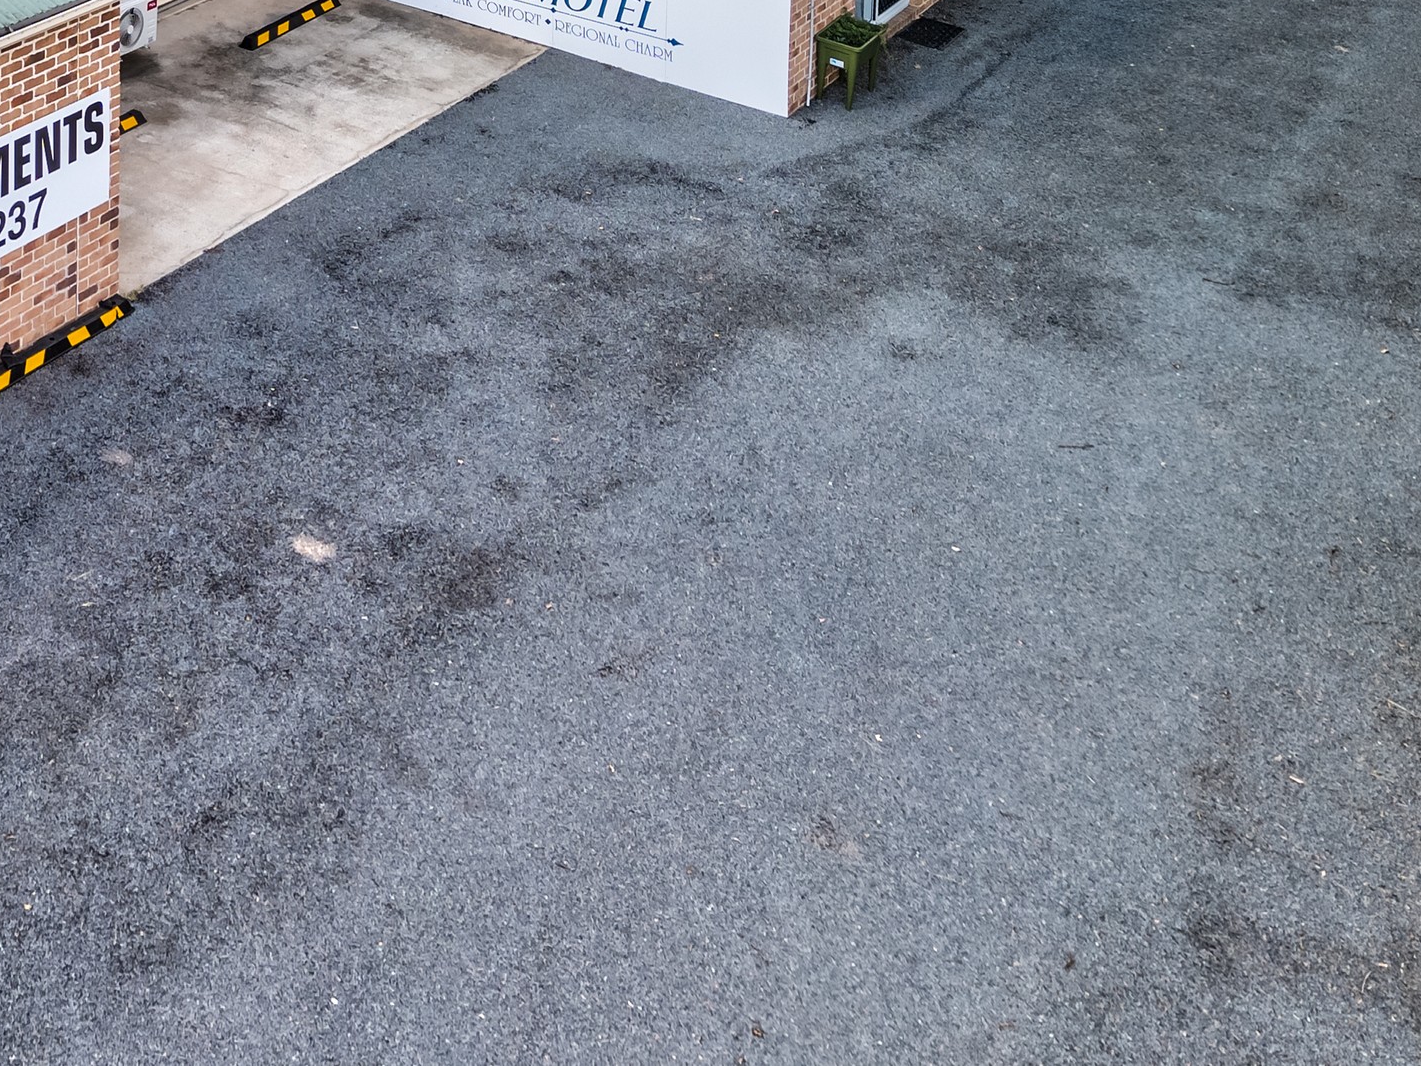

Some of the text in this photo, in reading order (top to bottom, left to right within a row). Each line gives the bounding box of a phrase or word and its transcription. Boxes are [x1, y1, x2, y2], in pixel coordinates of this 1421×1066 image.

[477, 0, 542, 26] COMFORT
[555, 19, 621, 49] REGIONAL
[625, 40, 674, 63] CHARM
